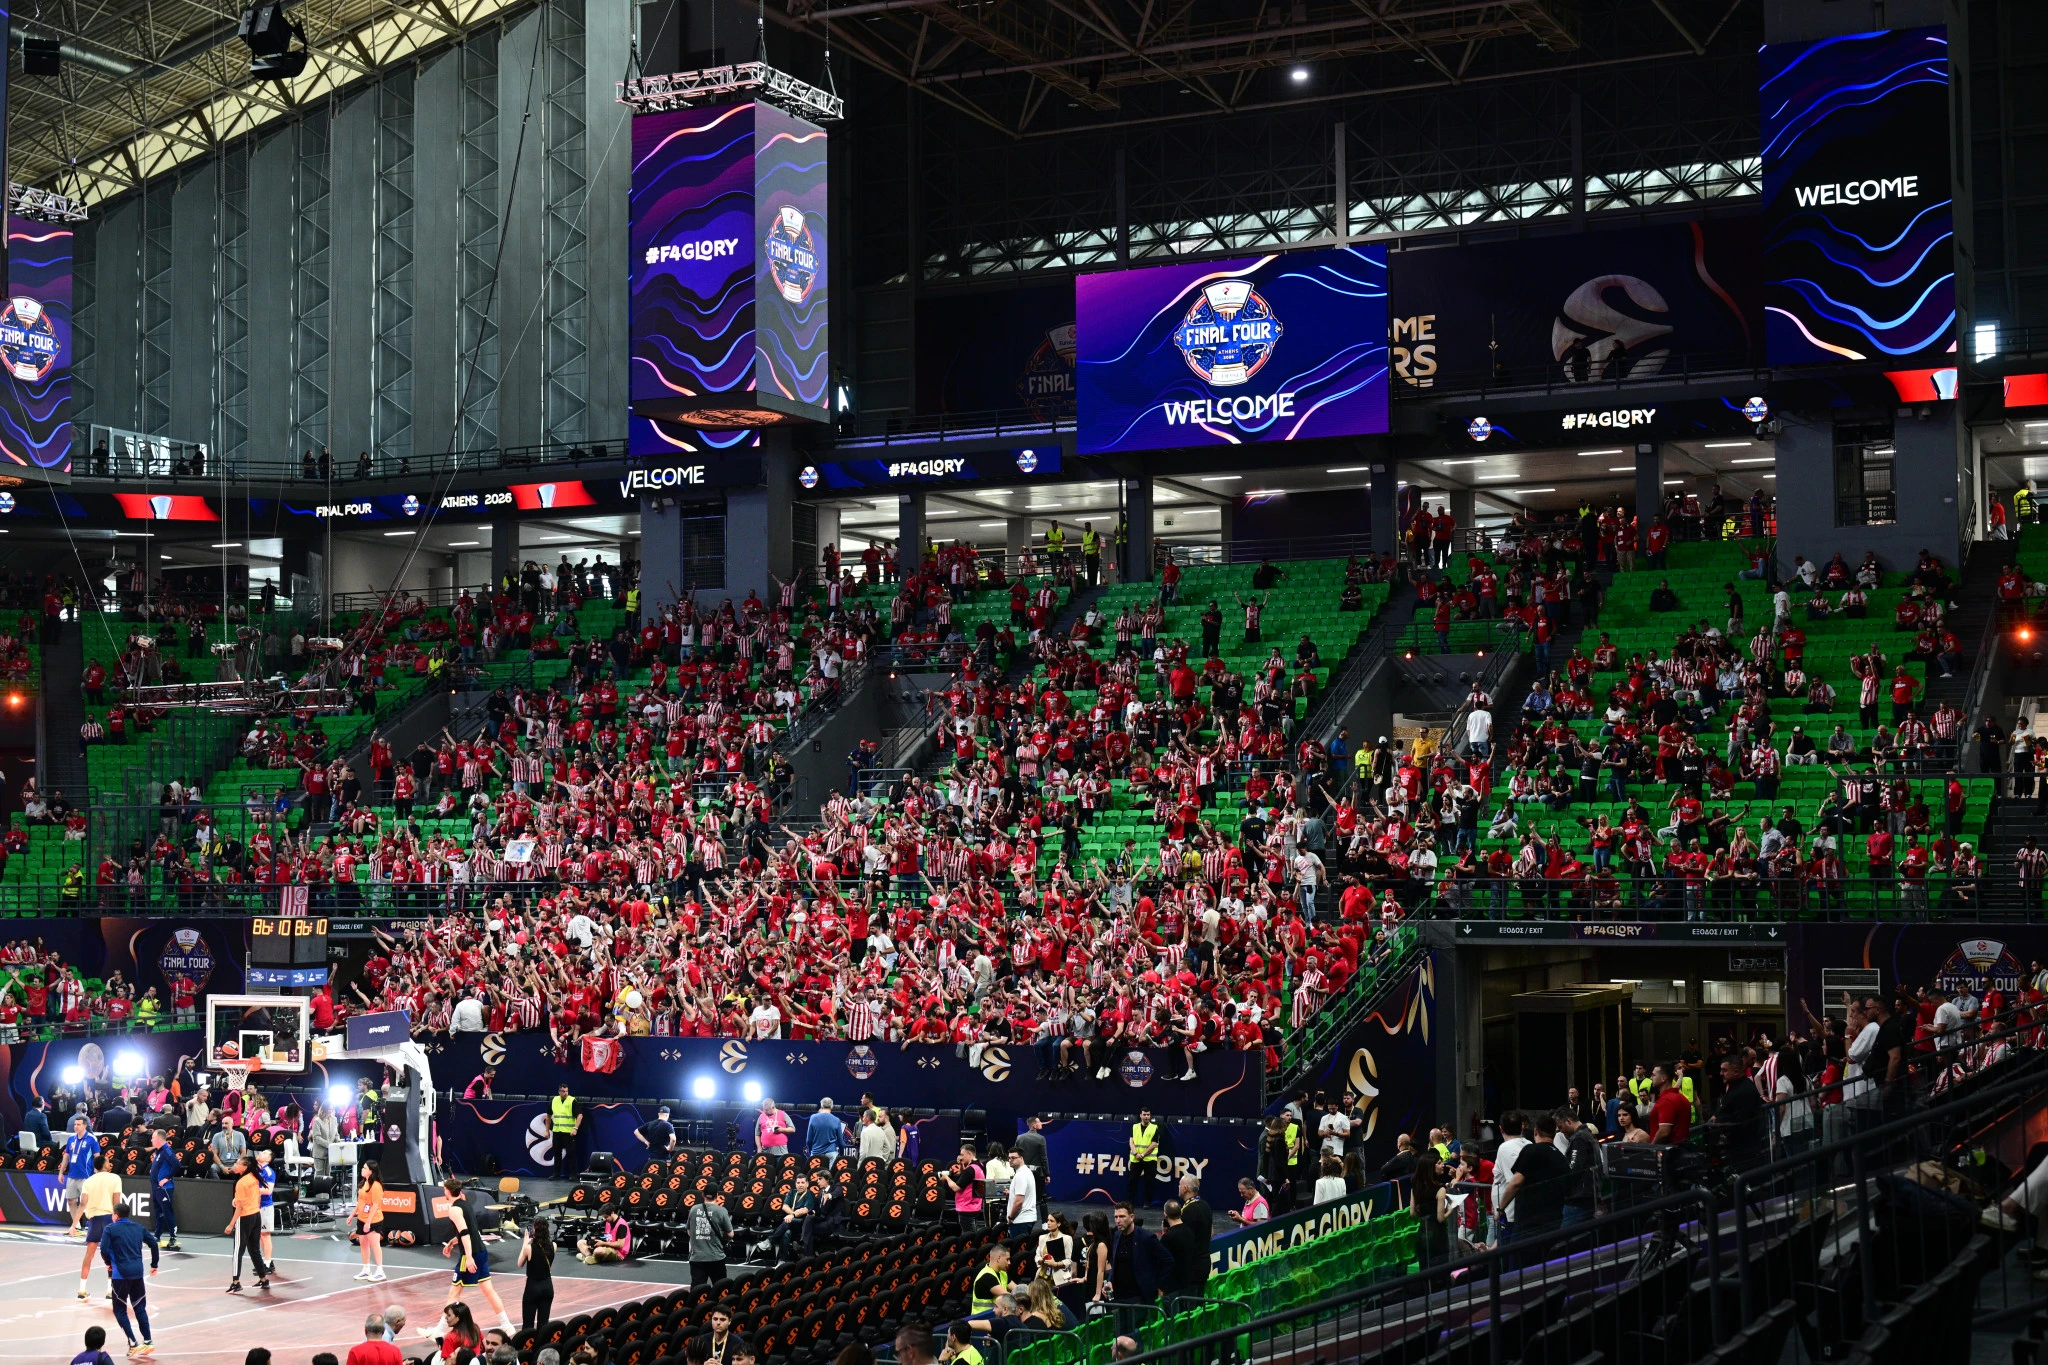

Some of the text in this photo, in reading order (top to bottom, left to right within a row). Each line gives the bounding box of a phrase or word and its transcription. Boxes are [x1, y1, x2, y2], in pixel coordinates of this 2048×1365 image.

[1794, 175, 1919, 209] WELCOME
[645, 237, 739, 265] #F4GLORY
[770, 240, 814, 270] FINAL FOUR
[0, 327, 54, 352] FINAL FOUR
[1186, 322, 1272, 346] FINAL FOUR
[1389, 314, 1436, 342] ME
[1028, 373, 1075, 395] FINAL
[1163, 392, 1296, 426] WELCOME
[1561, 407, 1656, 430] #F4GLORY
[888, 458, 965, 478] #F4GLORY
[315, 502, 372, 518] FINAL FOUR
[440, 492, 513, 509] ATHENS 2026
[337, 864, 346, 873] 15
[1498, 926, 1524, 935] ΕΞΟΔΟΣ
[1529, 926, 1544, 934] EXIT
[1583, 924, 1643, 938] #F4GLORY
[1691, 928, 1718, 936] ΕΞΟΔΟΣ
[1723, 928, 1739, 936] EXIT
[163, 956, 210, 969] FINAL FOUR
[1076, 1152, 1209, 1183] #F4ORY
[1290, 1218, 1316, 1248] OF
